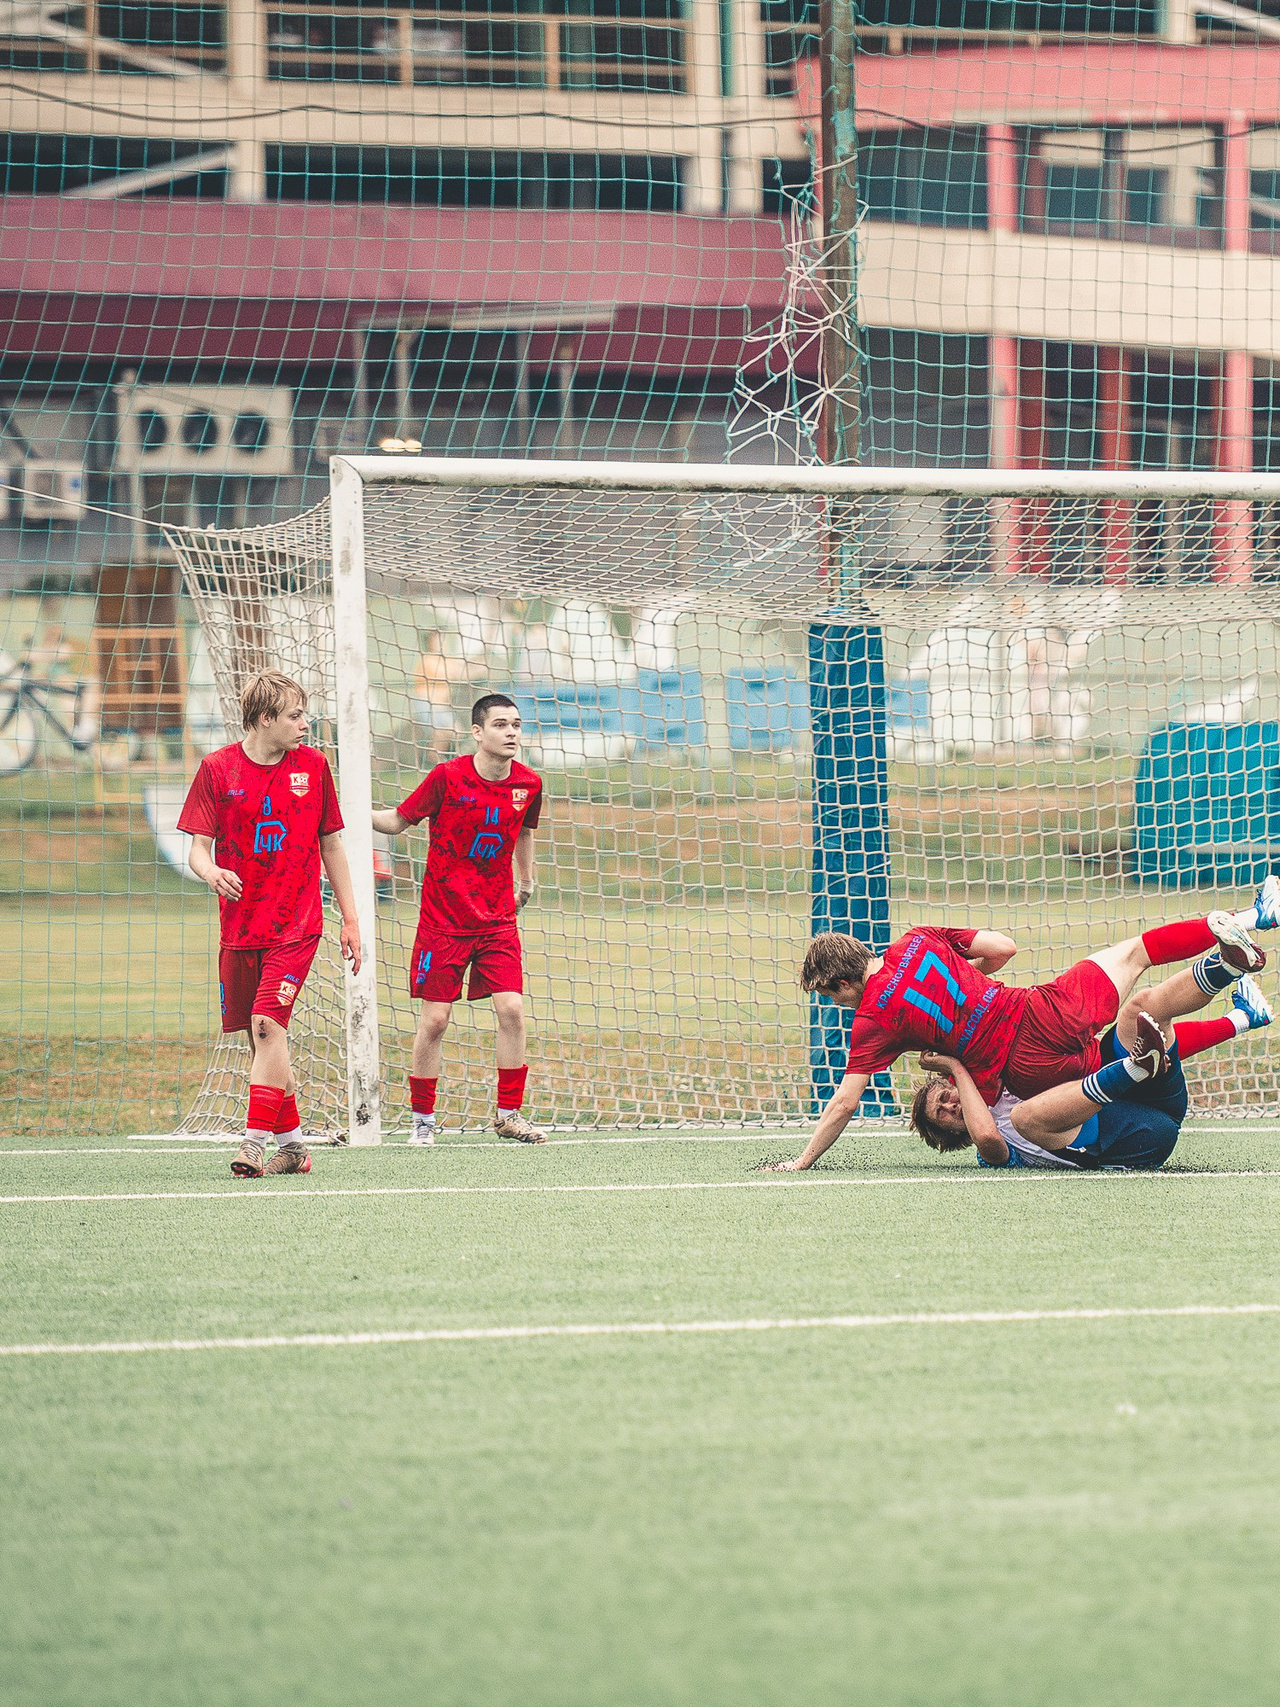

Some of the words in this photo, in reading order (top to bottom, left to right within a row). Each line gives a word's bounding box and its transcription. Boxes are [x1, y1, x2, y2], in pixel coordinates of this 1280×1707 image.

[262, 795, 272, 816] 8
[485, 806, 499, 826] 14
[418, 949, 432, 973] 14
[902, 949, 968, 1035] 17
